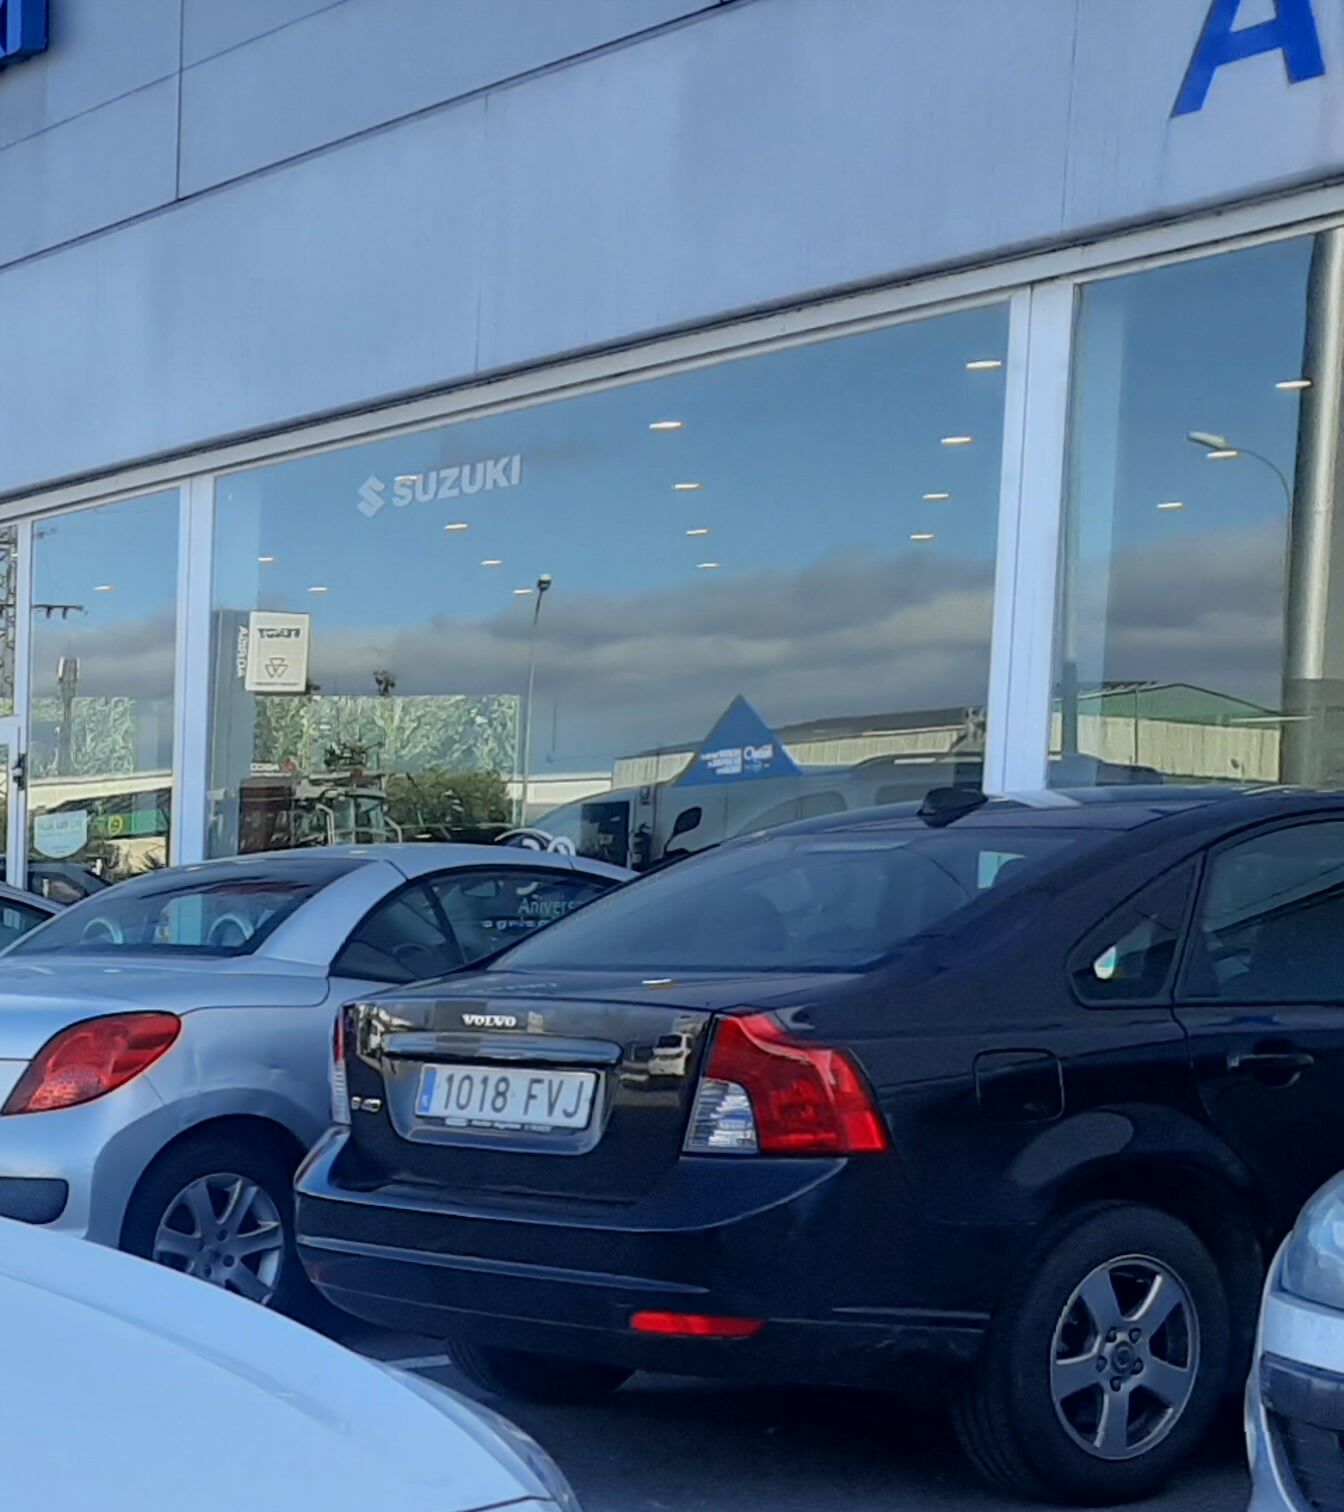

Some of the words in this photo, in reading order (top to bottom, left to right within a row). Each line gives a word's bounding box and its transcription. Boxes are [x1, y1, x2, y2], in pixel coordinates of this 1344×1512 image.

[392, 455, 521, 507] SUZUKI
[462, 1014, 517, 1028] VOLVO
[444, 1073, 511, 1113] 1018
[523, 1078, 584, 1118] FVJ
